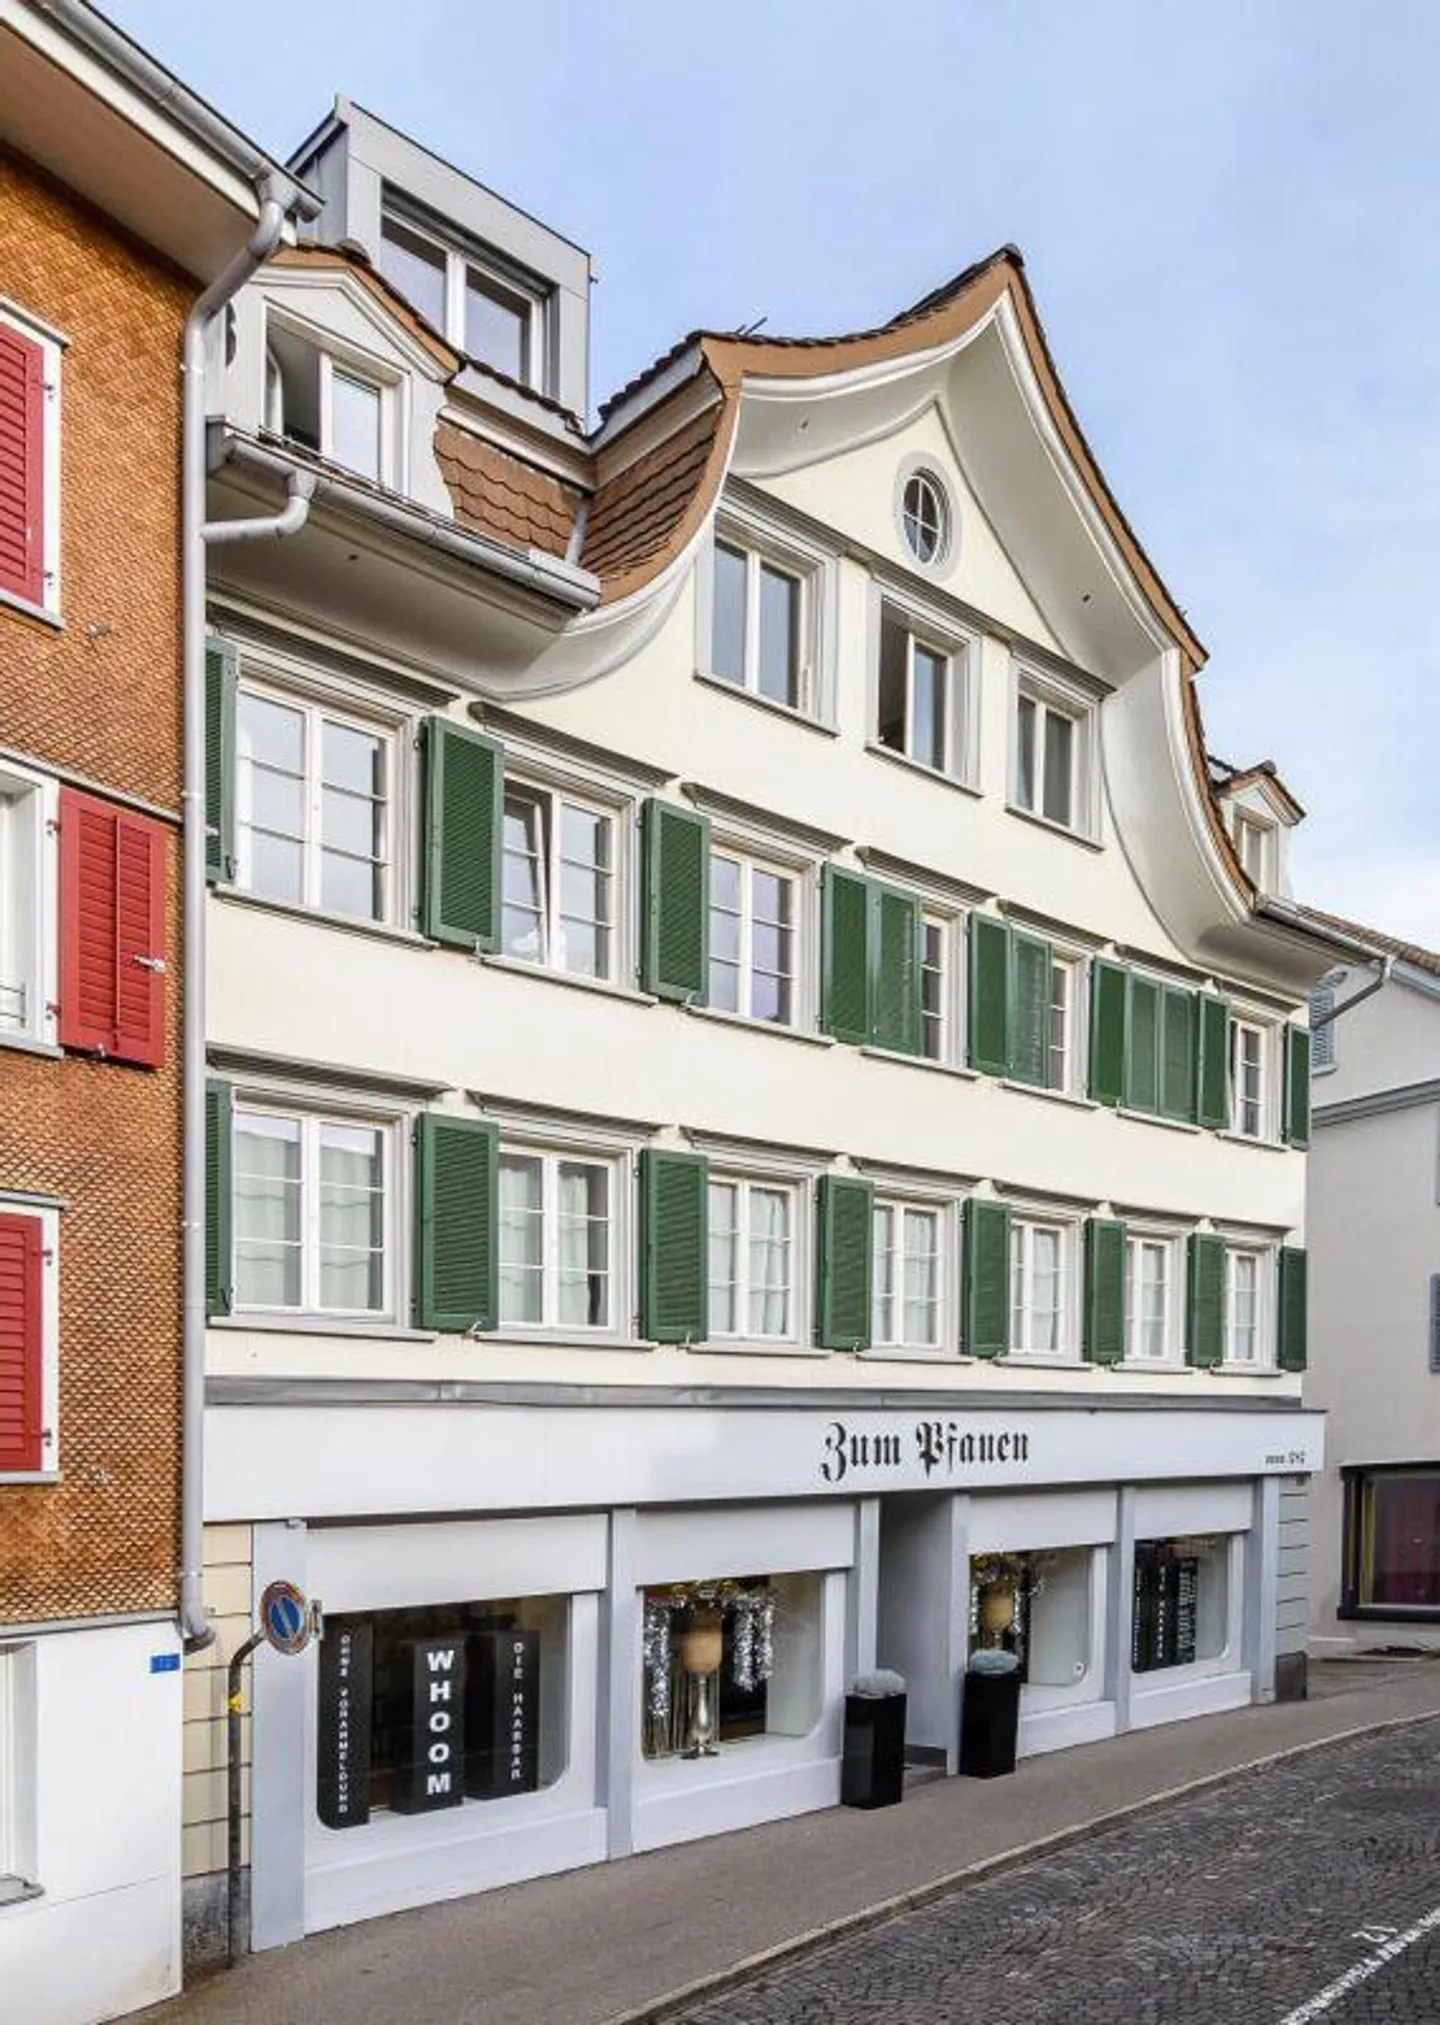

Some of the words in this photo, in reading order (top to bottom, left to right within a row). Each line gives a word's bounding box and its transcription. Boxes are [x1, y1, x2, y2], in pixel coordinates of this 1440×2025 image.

[820, 1421, 900, 1482] Zum
[916, 1421, 1029, 1479] Pfauen
[426, 1649, 455, 1796] WHOOM
